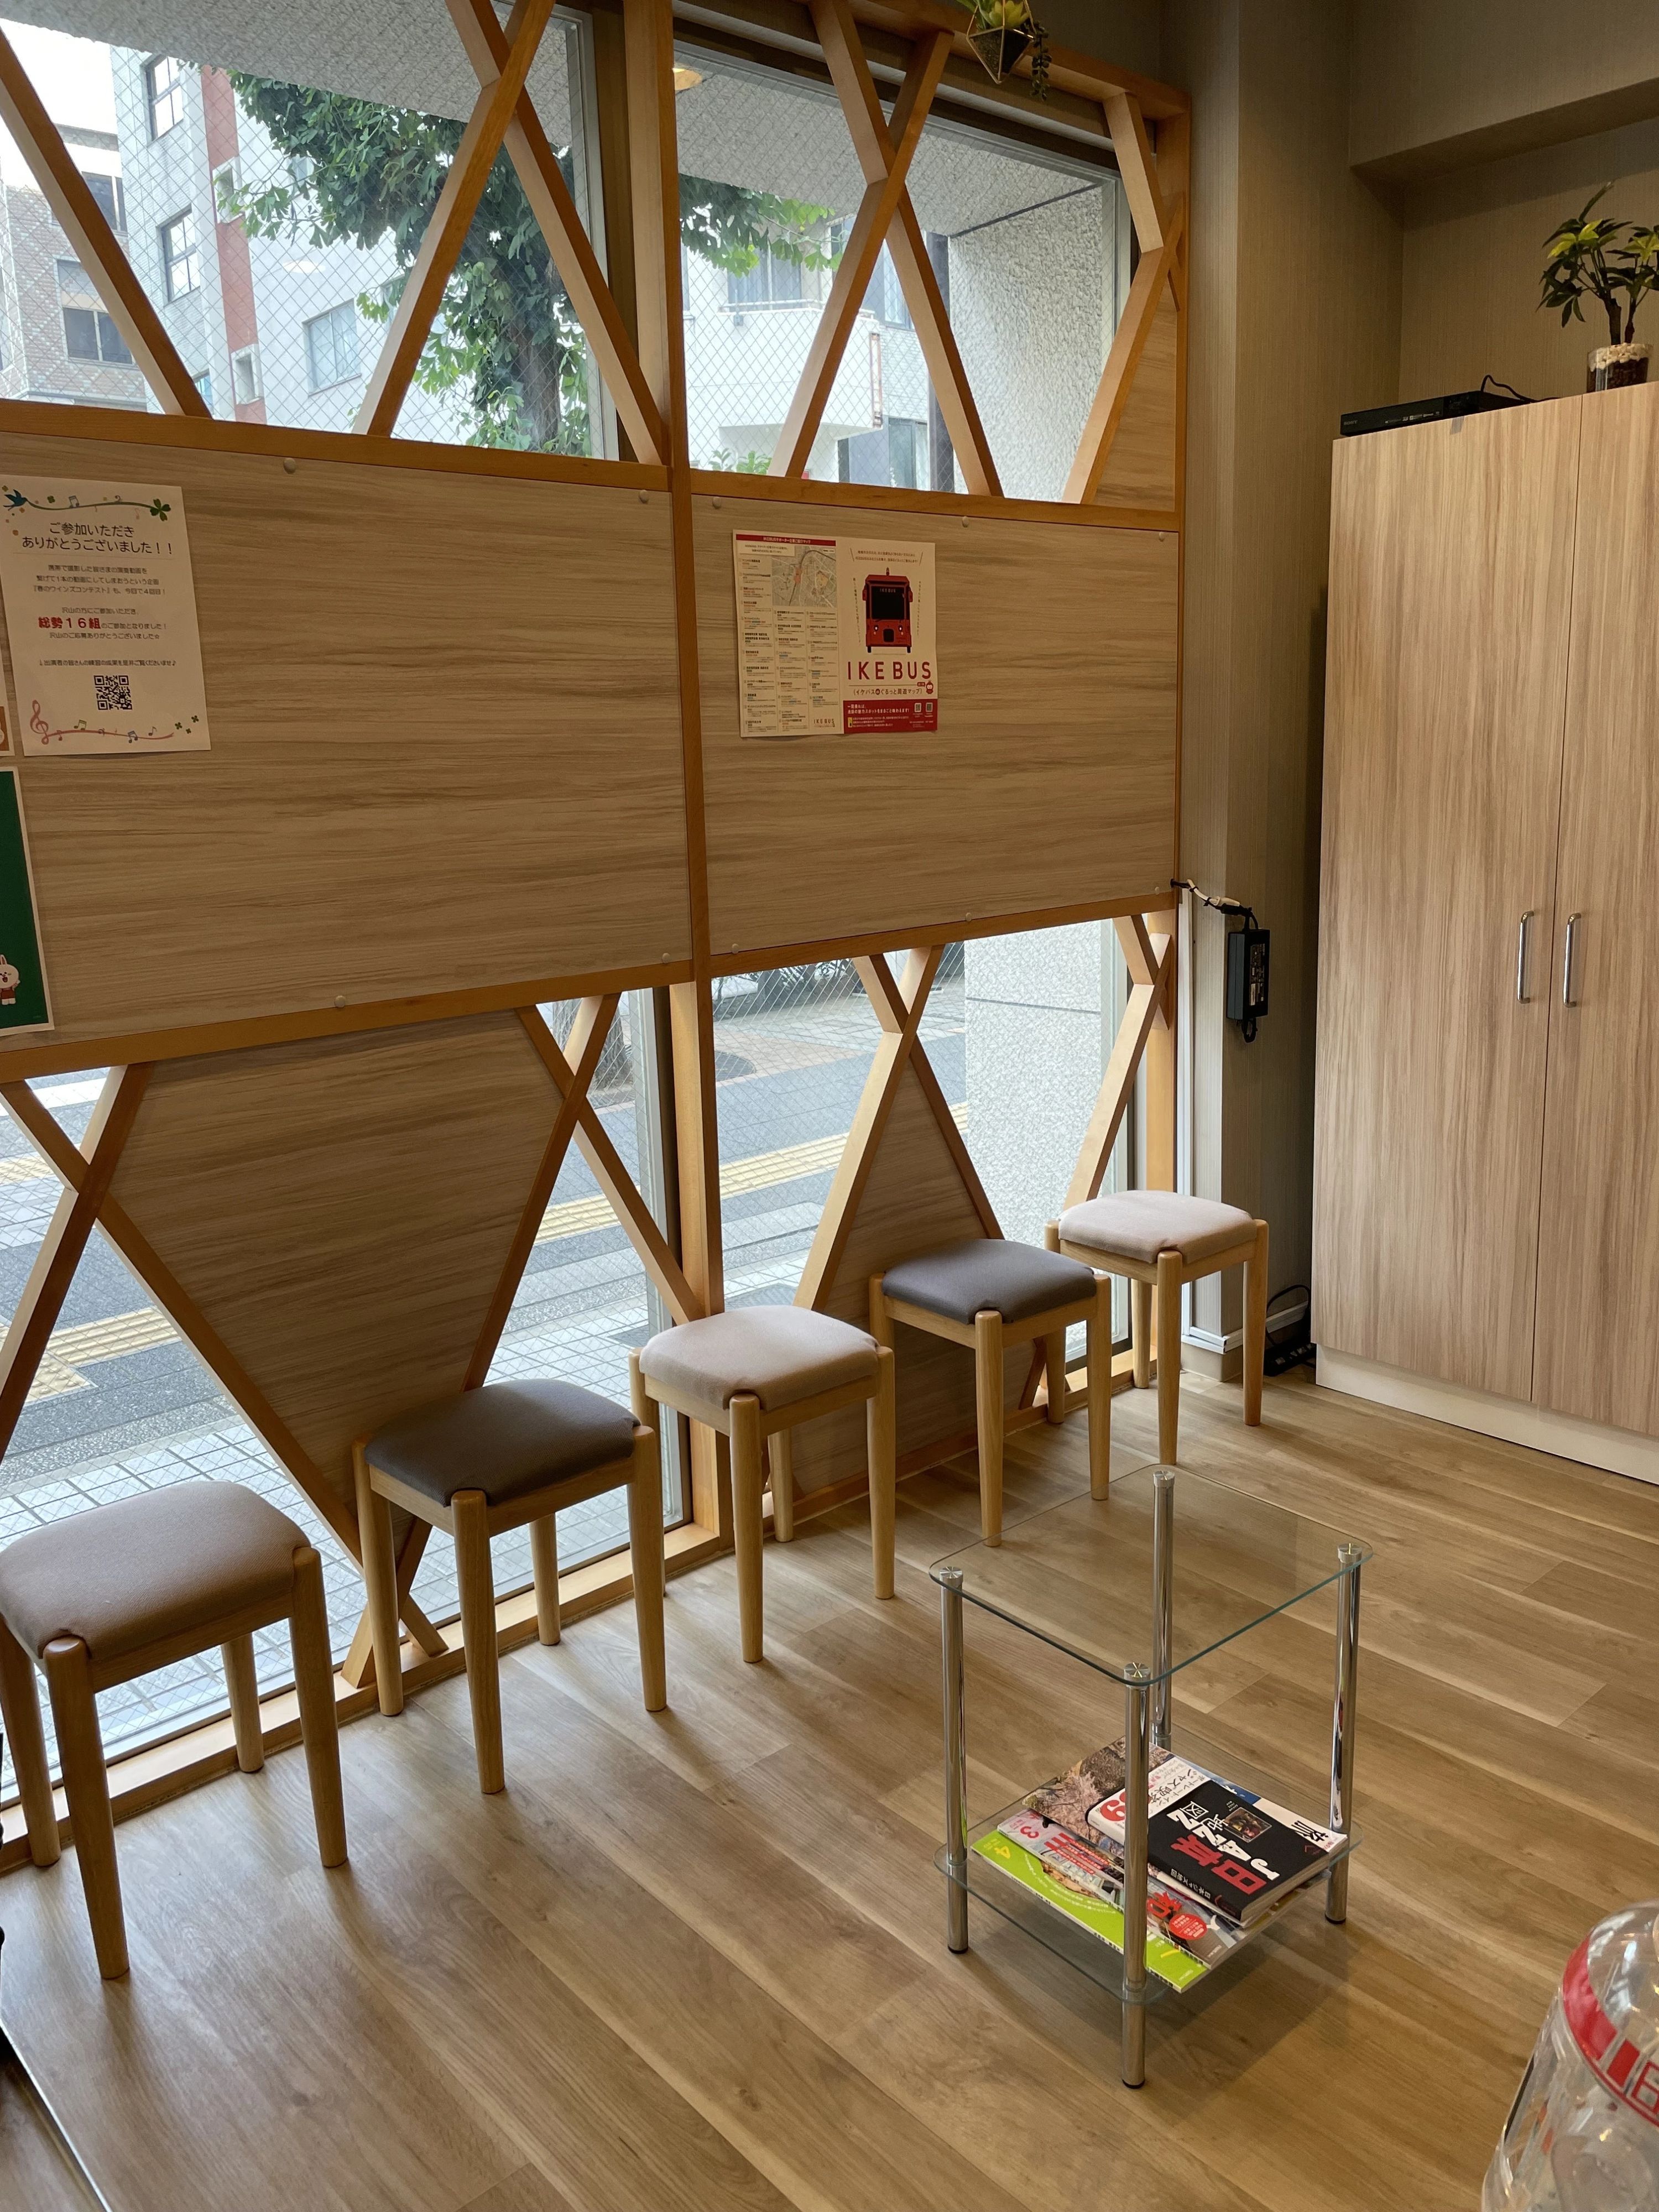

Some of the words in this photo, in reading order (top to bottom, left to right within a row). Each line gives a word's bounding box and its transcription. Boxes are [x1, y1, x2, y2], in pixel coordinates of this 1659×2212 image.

[50, 523, 134, 537] ご参加いただき
[22, 536, 173, 554] ありがとうございました！！
[1180, 1801, 1229, 1832] 地図
[1020, 1826, 1039, 1839] 3
[994, 1846, 1011, 1859] 4
[1166, 1809, 1280, 1880] JAZZ
[1170, 1834, 1267, 1896] 日本
